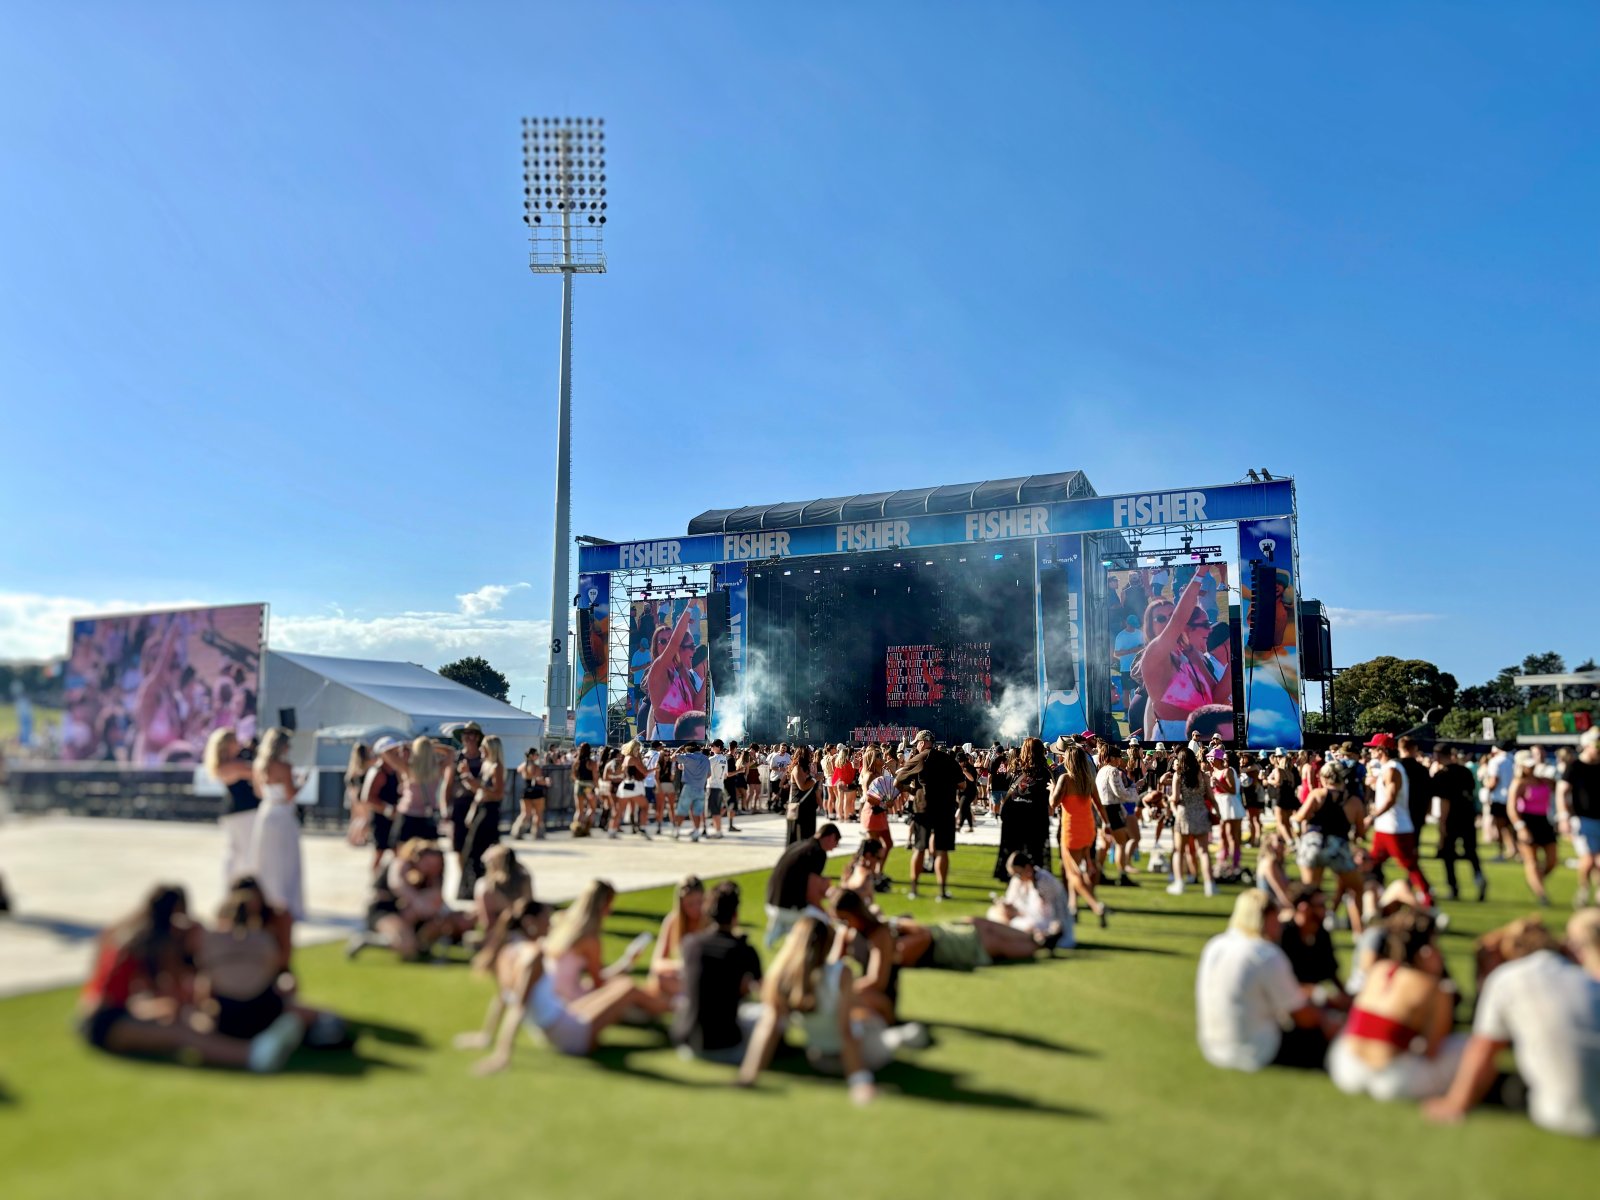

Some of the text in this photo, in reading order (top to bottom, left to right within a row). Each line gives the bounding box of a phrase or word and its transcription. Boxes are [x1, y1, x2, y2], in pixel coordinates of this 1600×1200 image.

[965, 506, 1050, 541] FISHER
[1113, 491, 1208, 528] FISHER
[723, 531, 791, 561] FISHER
[836, 521, 911, 552] FISHER
[619, 540, 681, 569] FISHER
[1042, 556, 1074, 565] Tramark
[552, 638, 562, 654] 3
